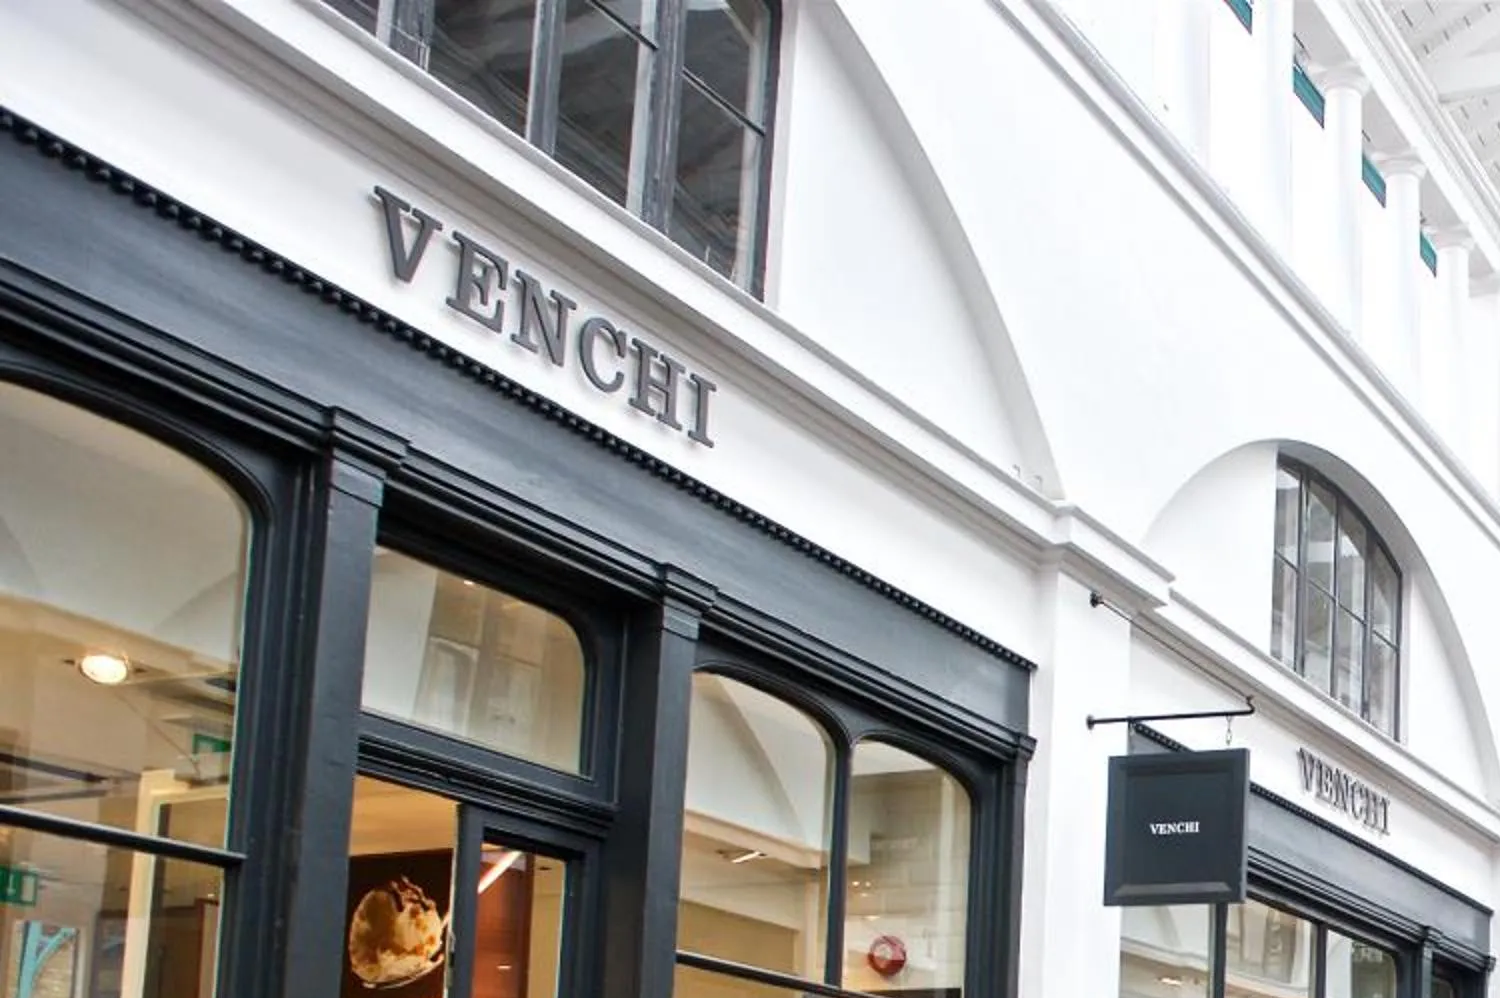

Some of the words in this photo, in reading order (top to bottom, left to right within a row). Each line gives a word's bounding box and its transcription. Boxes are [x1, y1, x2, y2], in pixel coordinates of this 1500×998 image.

[373, 185, 717, 449] VENCHI
[1149, 821, 1201, 835] VENCHI
[1297, 747, 1391, 836] VENCHI
